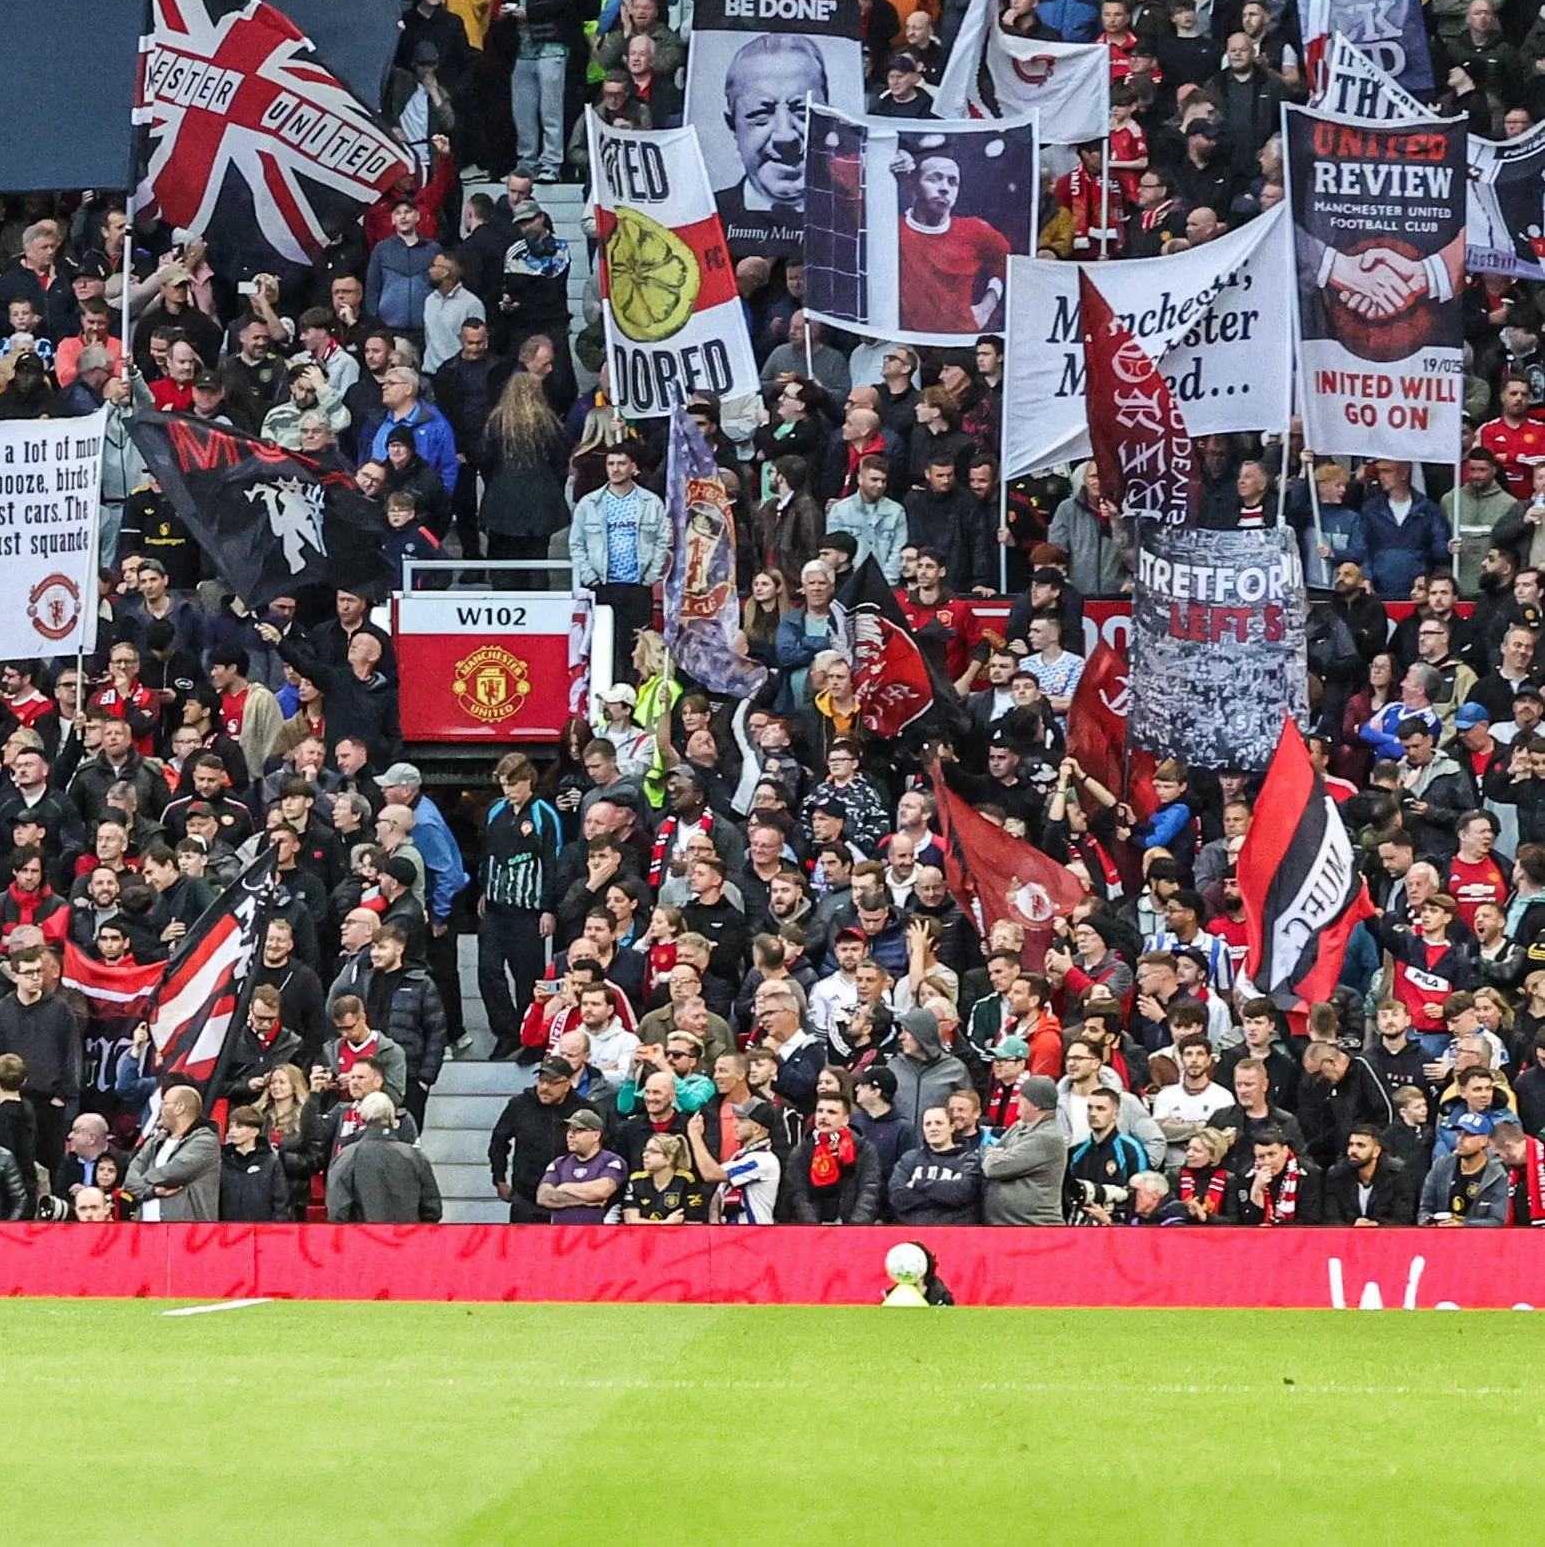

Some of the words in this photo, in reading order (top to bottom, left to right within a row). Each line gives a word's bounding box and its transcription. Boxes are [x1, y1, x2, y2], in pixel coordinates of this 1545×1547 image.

[268, 99, 388, 176] UNITED
[1313, 123, 1449, 161] UNITED
[1313, 160, 1454, 200] REVIEW
[1314, 201, 1403, 217] MANCHESTER
[1408, 207, 1452, 219] UNITED
[726, 224, 768, 245] Jimmy
[1330, 216, 1399, 232] FOOTBALL
[1404, 221, 1439, 233] CLUB
[1399, 375, 1457, 403] WILL
[1344, 401, 1378, 429] GO
[1387, 404, 1430, 432] ON
[5, 443, 14, 464] a
[23, 439, 47, 464] lot
[55, 435, 70, 460] of
[56, 467, 89, 492] birds
[24, 499, 62, 525] cars.
[65, 496, 89, 521] The
[456, 607, 527, 627] W102
[1169, 601, 1253, 644] LEFT
[460, 651, 523, 677] MANCHESTER
[470, 703, 514, 718] UNITED
[1413, 972, 1439, 990] FILA
